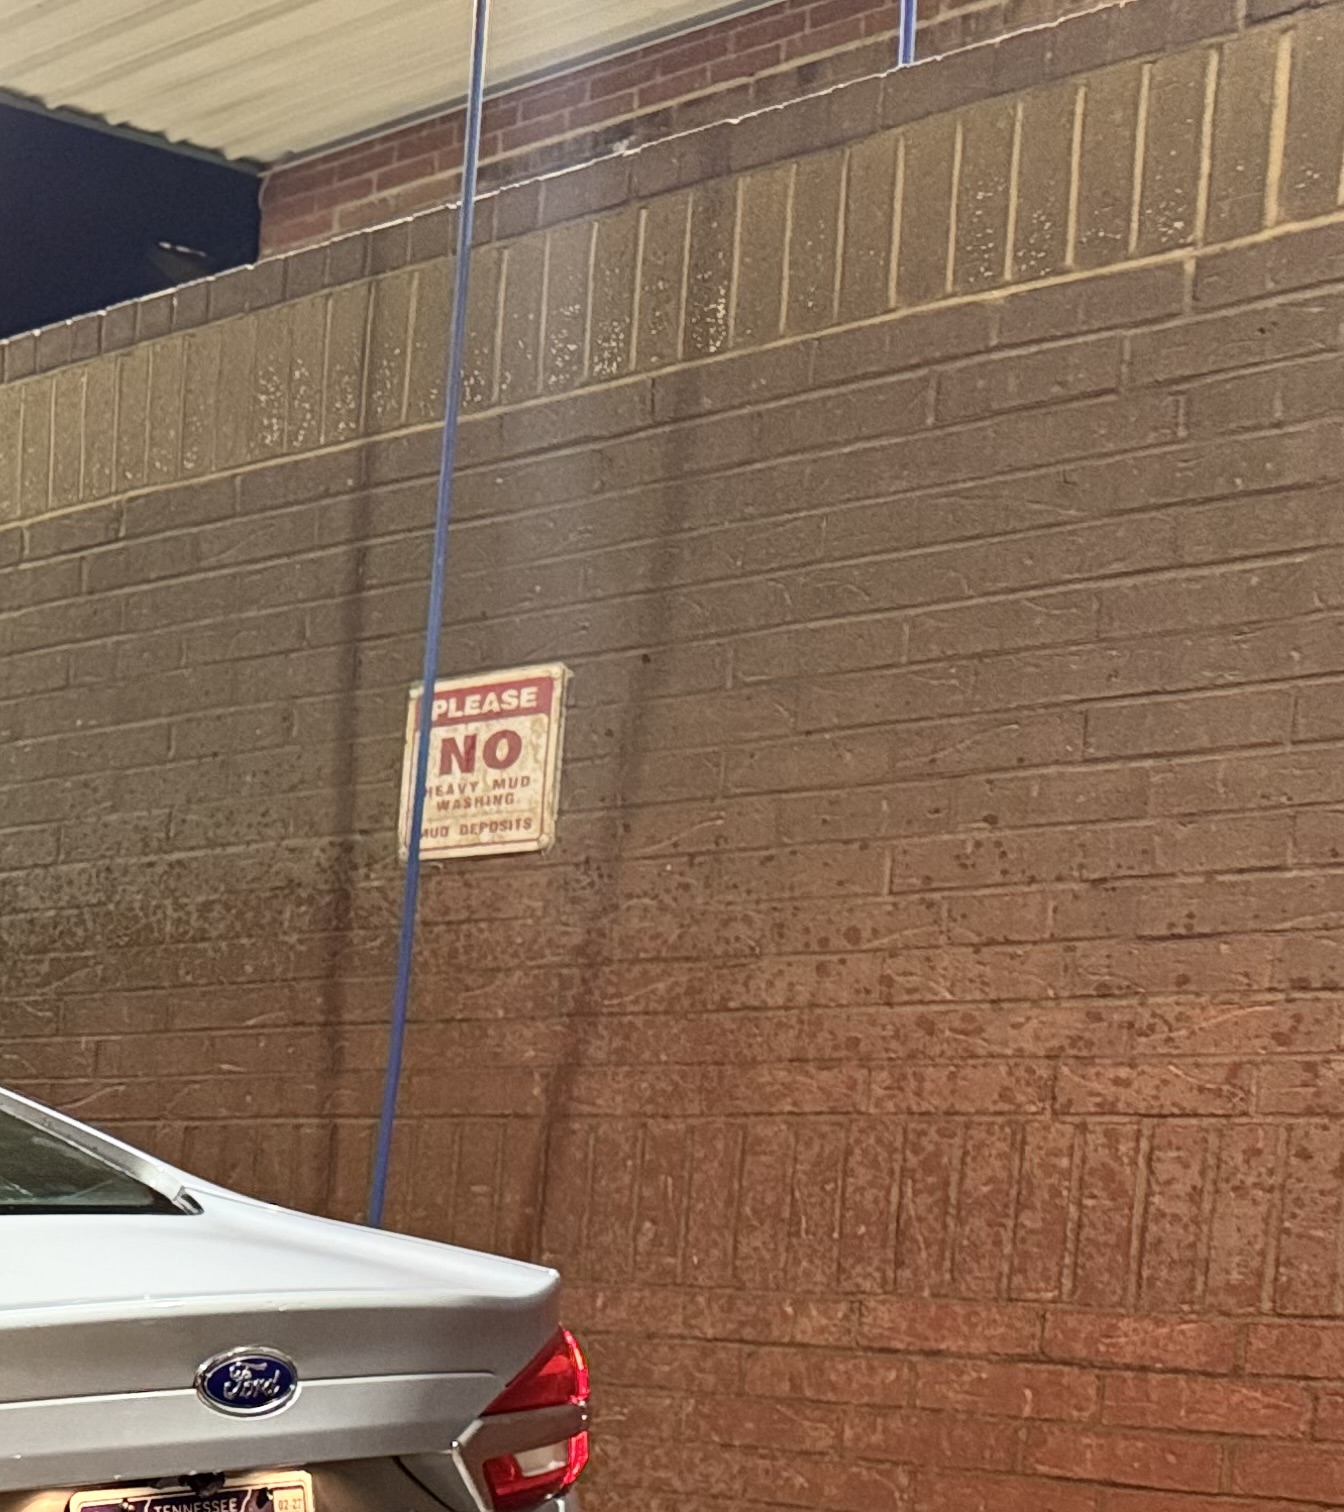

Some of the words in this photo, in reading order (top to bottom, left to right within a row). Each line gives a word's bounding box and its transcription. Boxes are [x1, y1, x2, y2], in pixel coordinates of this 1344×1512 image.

[431, 686, 539, 721] PLEASE
[438, 728, 523, 776] NO
[491, 775, 531, 791] MUD
[436, 792, 515, 812] WASHING
[458, 817, 533, 836] DEPOSITS
[223, 1361, 281, 1400] Ford
